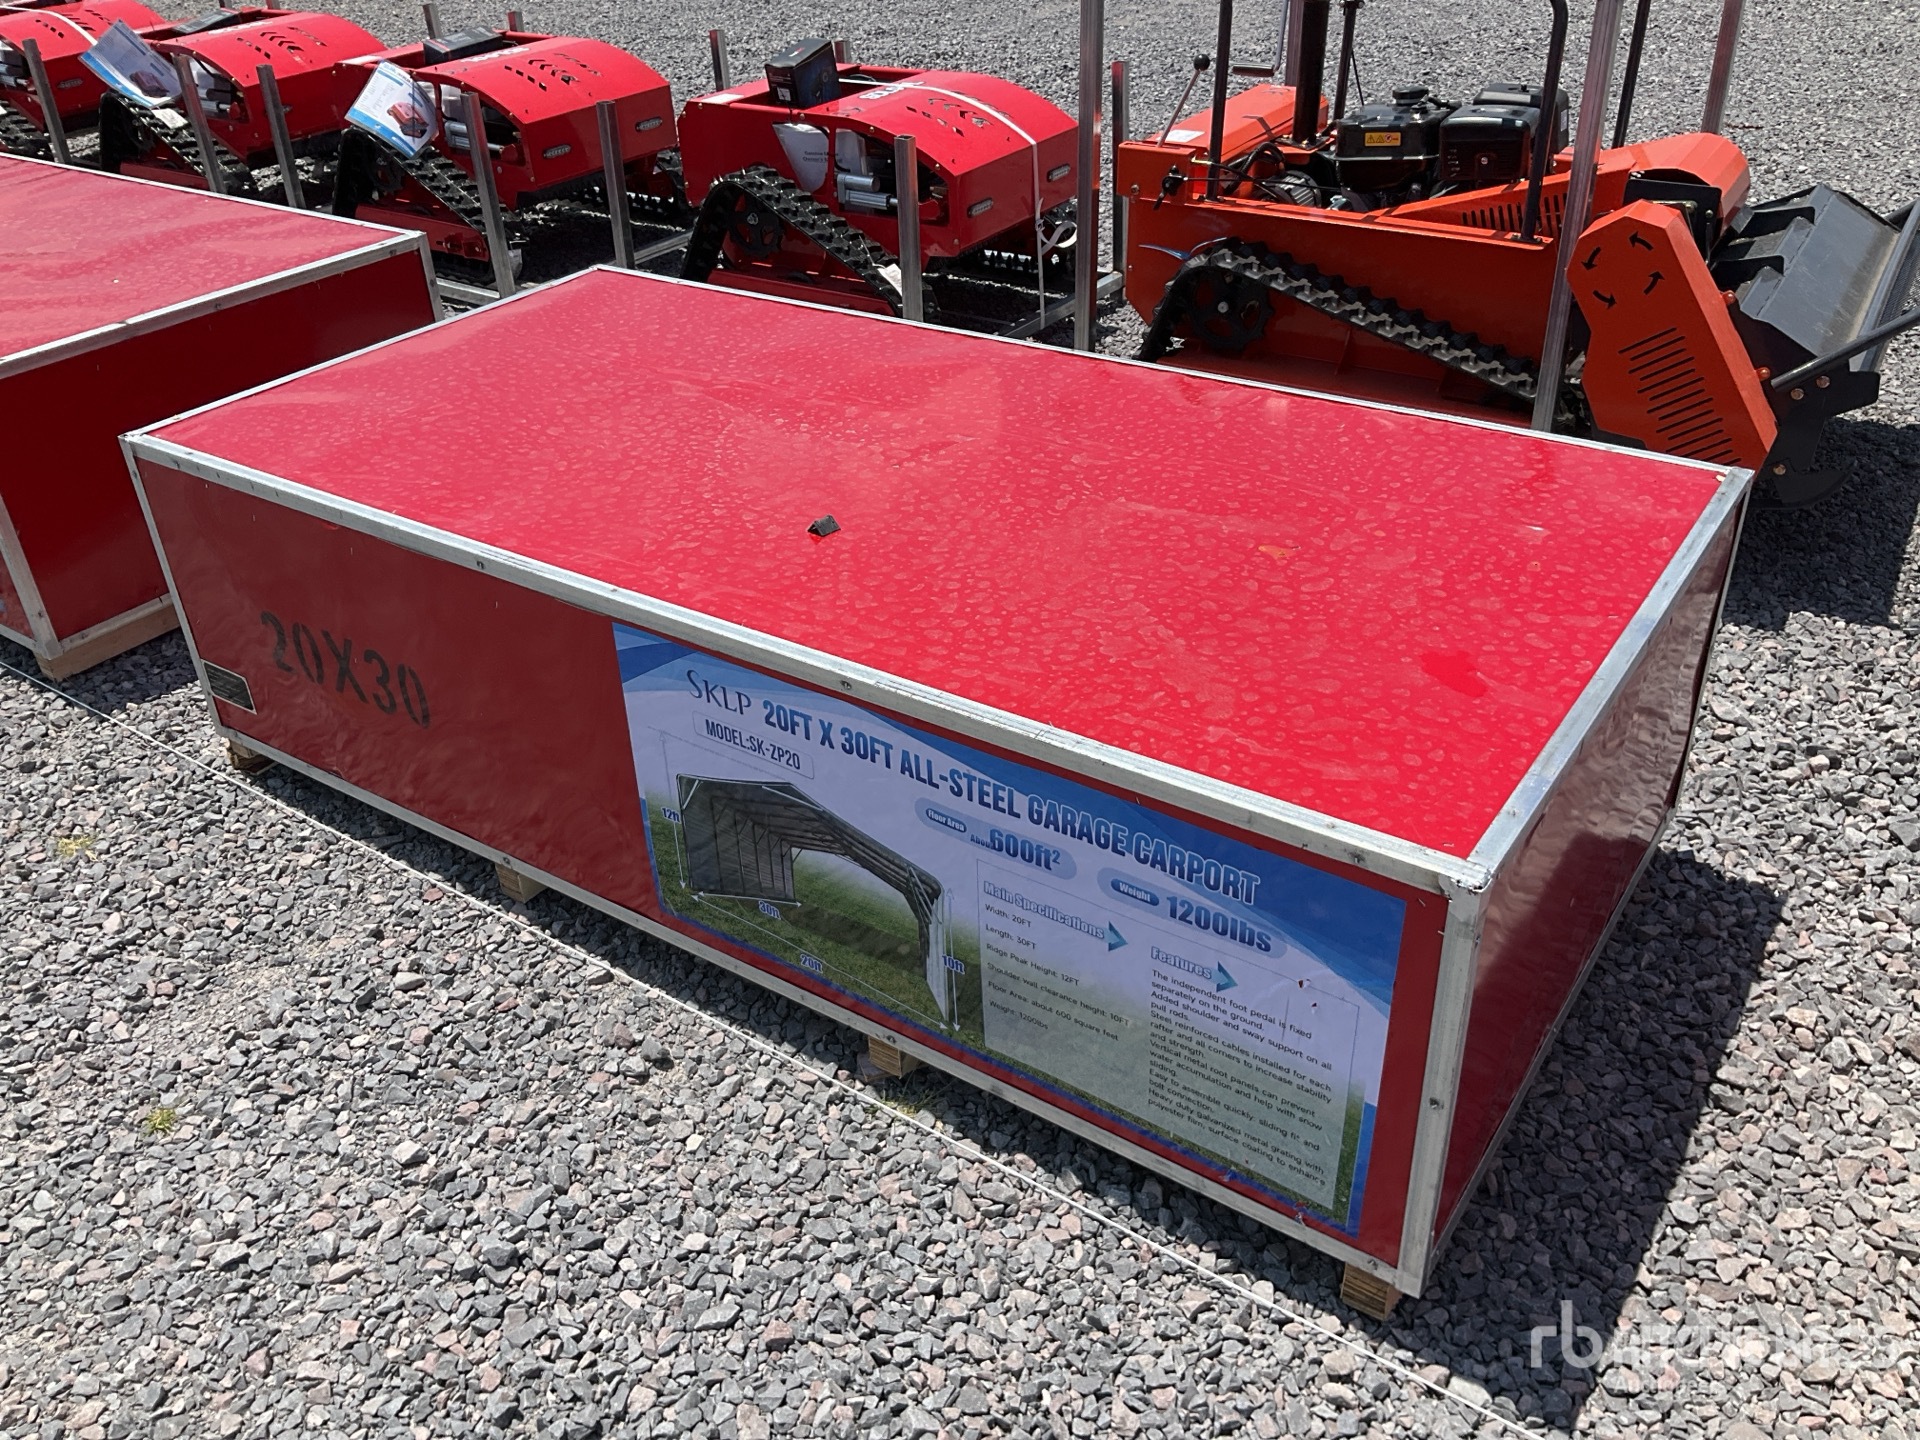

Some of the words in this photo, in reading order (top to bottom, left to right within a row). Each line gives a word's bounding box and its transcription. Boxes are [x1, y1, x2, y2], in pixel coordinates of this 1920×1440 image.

[260, 610, 430, 729] 20X30
[704, 717, 801, 771] MODEL:SK-ZP20
[661, 805, 680, 824] 12ft
[684, 666, 754, 720] SKLP
[760, 696, 814, 742] 20FT
[816, 717, 835, 750] X
[838, 724, 895, 771] 30FT
[897, 747, 1021, 820] ALL-STEEL
[1026, 791, 1128, 859] GARAGE
[1132, 829, 1261, 909] CARPORT
[927, 808, 946, 824] Floor
[946, 816, 964, 832] Area
[757, 899, 780, 919] 30ft
[982, 879, 1013, 904] Main
[1014, 891, 1105, 942] Specifications
[984, 903, 1009, 919] Width:
[1011, 913, 1031, 928] 20FT
[1118, 881, 1151, 903] Weight
[1165, 891, 1272, 955] 1200lbs
[800, 953, 823, 974] 20ft
[941, 953, 963, 974] 10ft
[986, 942, 1008, 959] Ridge
[1009, 951, 1027, 966] Peak
[1029, 960, 1057, 979] Height:
[1061, 972, 1079, 987] 12FT
[1016, 935, 1036, 950] 30FT
[1150, 944, 1212, 982] Features
[987, 961, 1020, 982] Shoulder
[1022, 976, 1037, 989] wall
[1040, 983, 1077, 1005] clearance
[1080, 1000, 1106, 1019] height:
[1109, 1012, 1130, 1027] 10FT
[987, 980, 1006, 994] Floor
[1031, 998, 1053, 1014] about
[1055, 1008, 1071, 1021] 600
[1073, 1017, 1100, 1035] square
[1102, 1028, 1118, 1042] feet
[989, 998, 1016, 1018] Weight:
[1019, 1011, 1048, 1030] 1200lbs
[1150, 999, 1166, 1013] pull
[1151, 978, 1195, 1005] separately
[1198, 998, 1210, 1009] on
[1212, 1003, 1227, 1016] the
[1151, 968, 1168, 982] The
[1170, 975, 1227, 1007] independent
[1229, 998, 1247, 1013] foot
[1249, 1008, 1276, 1027] pedal
[1278, 1019, 1286, 1029] is
[1288, 1023, 1311, 1040] fixed
[1149, 1029, 1166, 1042] and
[1150, 989, 1179, 1008] Added
[1181, 1001, 1219, 1024] shoulder
[1222, 1018, 1239, 1032] and
[1241, 1027, 1265, 1044] sway
[1267, 1037, 1303, 1060] support
[1305, 1054, 1318, 1065] on
[1320, 1060, 1332, 1071] all
[1150, 1009, 1172, 1025] Steel
[1174, 1018, 1219, 1044] reinforced
[1221, 1038, 1250, 1058] cables
[1252, 1051, 1290, 1075] installed
[1292, 1069, 1306, 1082] for
[1308, 1076, 1332, 1093] each
[1149, 1018, 1173, 1036] rafter
[1176, 1030, 1192, 1043] and
[1195, 1038, 1205, 1049] all
[1208, 1044, 1241, 1064] corners
[1243, 1059, 1252, 1069] to
[1255, 1064, 1293, 1087] increase
[1295, 1081, 1332, 1105] stability
[1149, 1038, 1181, 1059] Vertical
[1183, 1053, 1207, 1070] metal
[1209, 1065, 1228, 1079] root
[1230, 1074, 1259, 1094] panels
[1261, 1088, 1278, 1102] can
[1280, 1096, 1316, 1119] prevent
[1149, 1049, 1173, 1065] water
[1175, 1060, 1231, 1091] accumulation
[1234, 1086, 1251, 1100] and
[1253, 1094, 1273, 1111] help
[1276, 1105, 1296, 1120] with
[1297, 1116, 1323, 1132] snow
[1149, 1067, 1168, 1083] Easy
[1170, 1078, 1179, 1088] to
[1181, 1082, 1221, 1107] assemble
[1258, 1117, 1287, 1138] sliding
[1302, 1138, 1320, 1152] and
[1148, 1087, 1173, 1105] Heavy
[1175, 1100, 1194, 1115] duty
[1243, 1131, 1268, 1148] metal
[1270, 1144, 1302, 1166] grating
[1304, 1160, 1325, 1175] with
[1207, 1124, 1239, 1144] surface
[1241, 1140, 1273, 1162] coating
[1276, 1156, 1286, 1167] to
